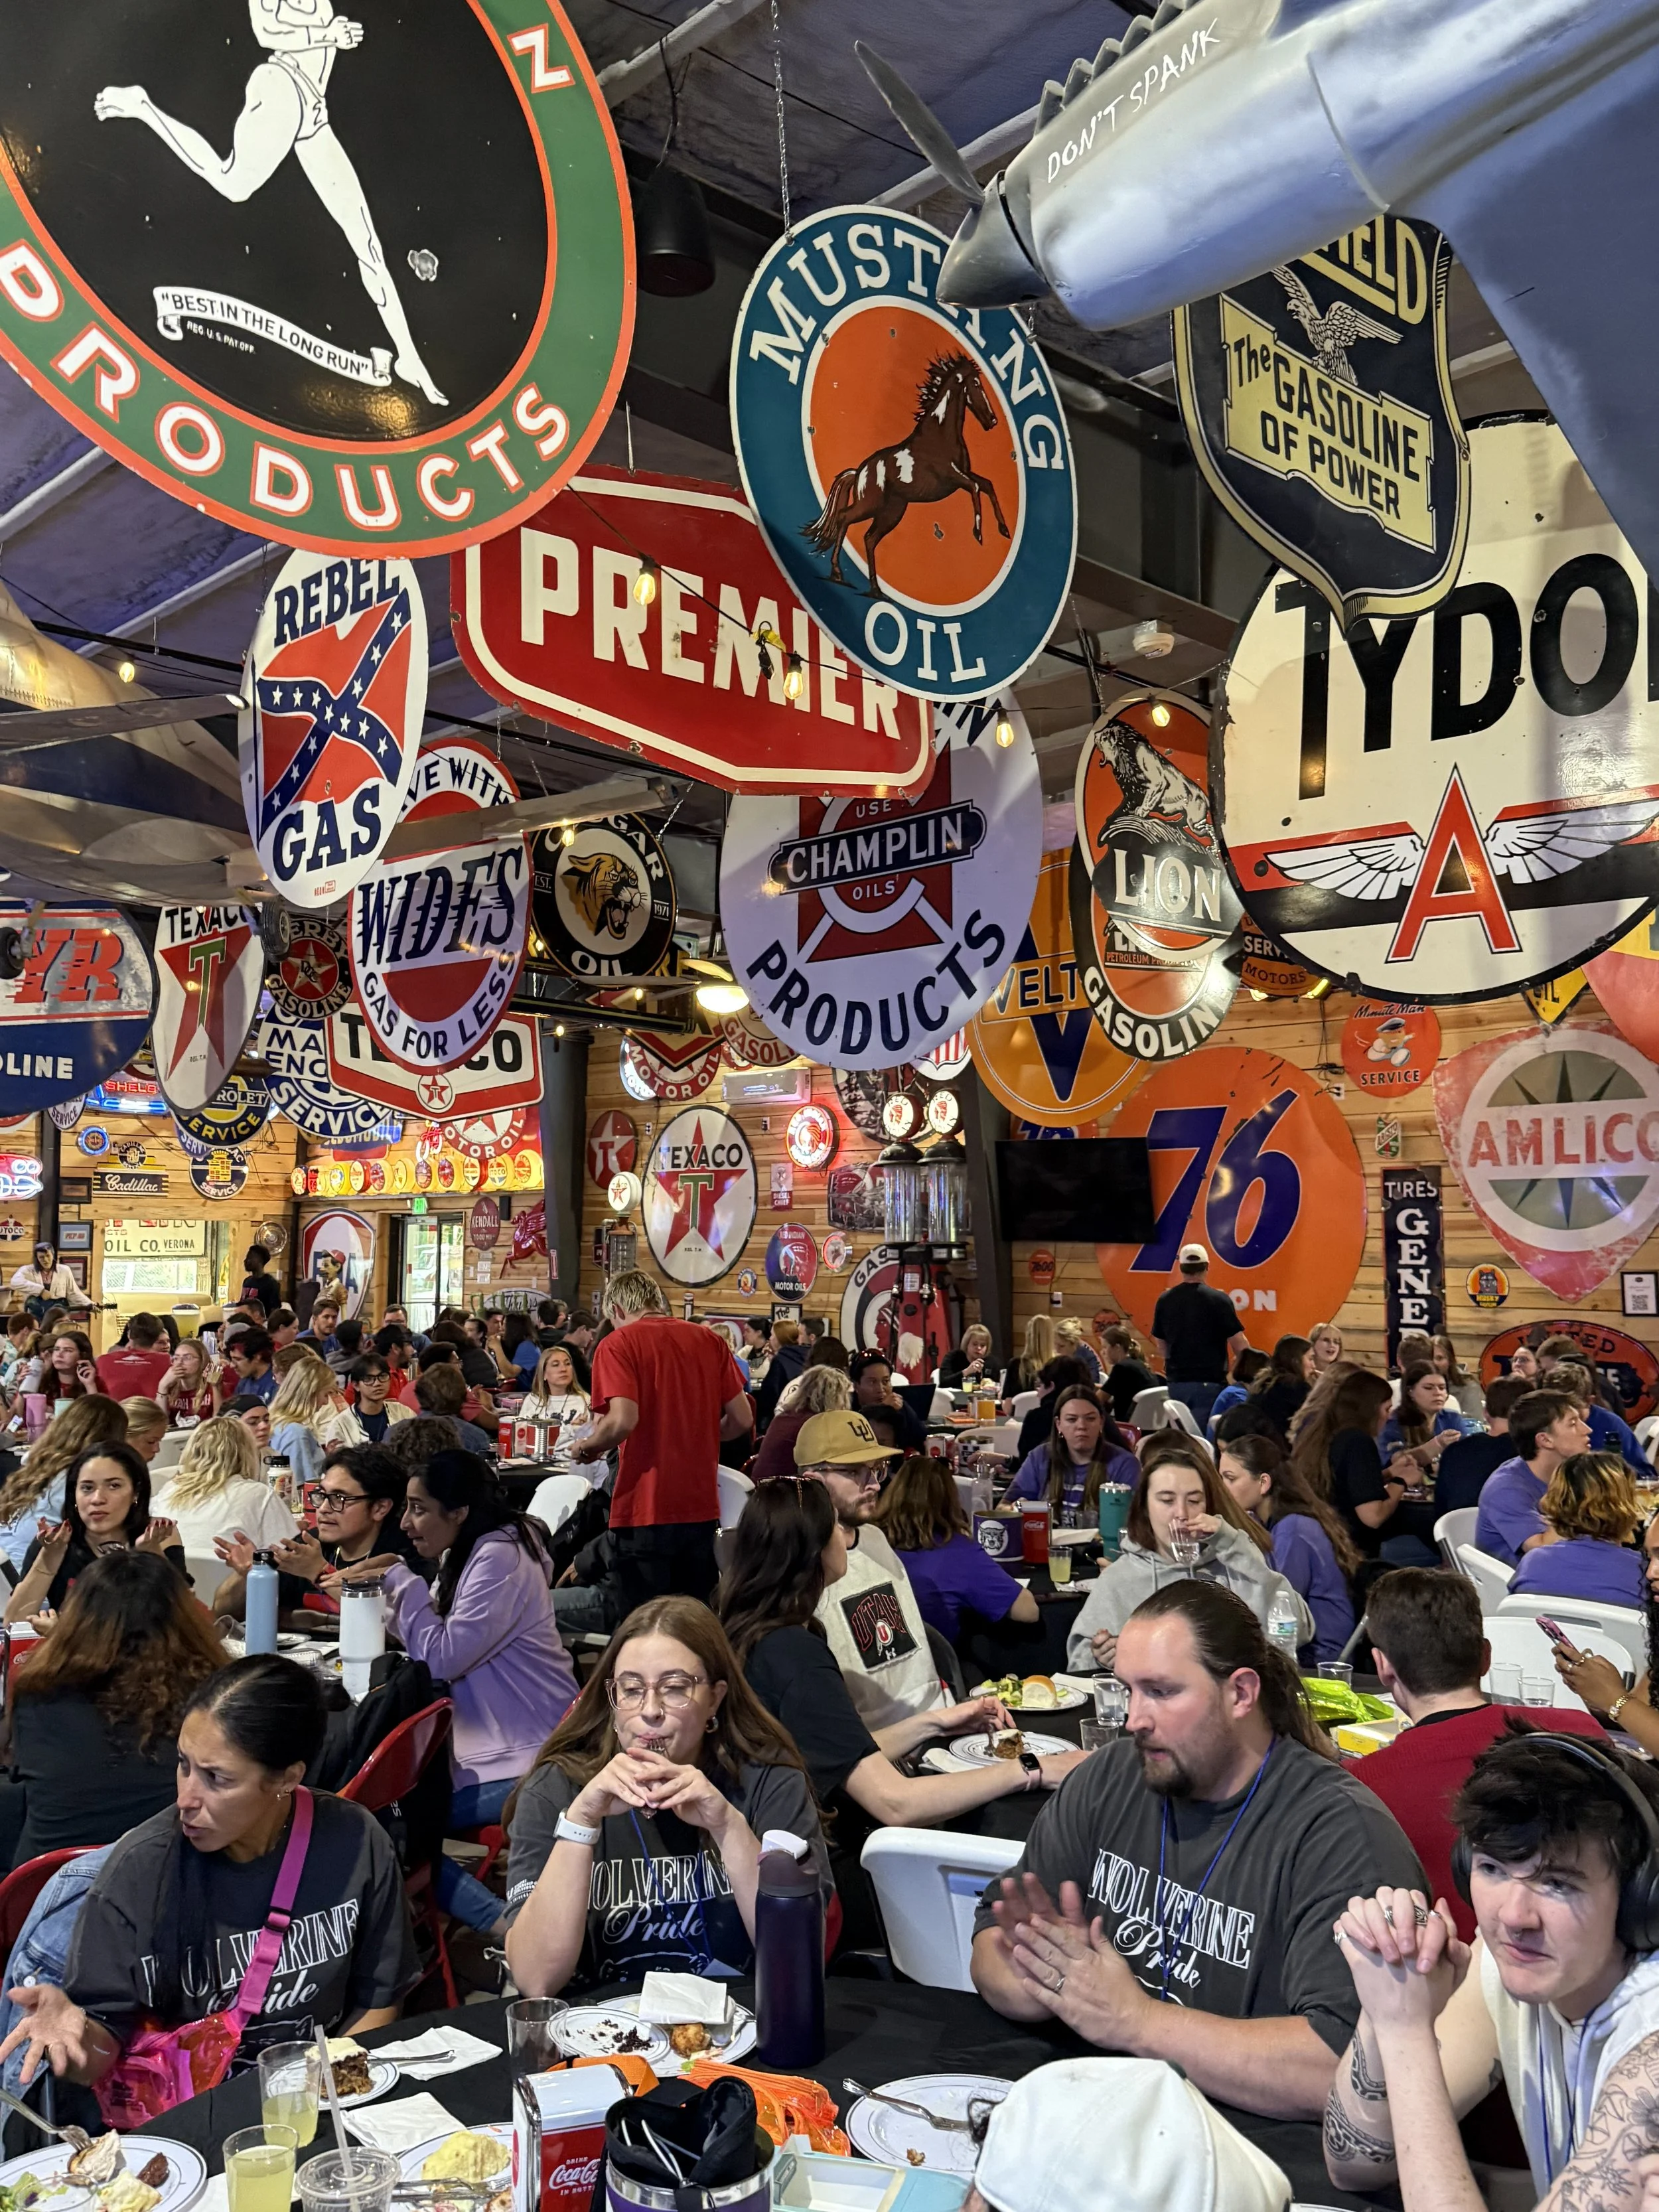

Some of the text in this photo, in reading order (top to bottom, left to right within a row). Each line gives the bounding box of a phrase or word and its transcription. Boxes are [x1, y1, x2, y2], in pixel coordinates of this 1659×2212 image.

[1046, 18, 1221, 183] DON'T SPANK
[219, 305, 238, 322] IN
[242, 308, 275, 336] THE
[279, 325, 323, 360] LONG
[0, 240, 570, 531] PRODUCTS
[1233, 332, 1420, 482] The GASOLINE
[1261, 411, 1400, 520] OF POWER
[274, 559, 399, 648] REBEL
[521, 526, 901, 741] PREMIER
[865, 601, 986, 683] OIL
[448, 757, 510, 809] WITH
[855, 800, 893, 819] USE
[274, 785, 381, 881] GAS
[543, 814, 664, 881] CGAR
[786, 812, 964, 884] CHAMPLIN
[534, 874, 552, 891] EST.
[1115, 849, 1221, 923] LION
[1385, 763, 1523, 964] A
[356, 846, 524, 969] WIDES
[852, 880, 897, 900] OILS
[289, 921, 348, 958] ERBY
[1106, 952, 1149, 965] PETROLEUM
[571, 950, 633, 977] OIL
[746, 909, 1005, 1055] PRODUCTS
[1245, 963, 1307, 985] MOTORS
[268, 973, 352, 1019] GASOLINE
[363, 947, 515, 1061] GAS FOR LESS
[995, 962, 1080, 1016] VELT
[1354, 1003, 1426, 1019] Minute Man
[724, 1018, 798, 1063] GASOLI
[0, 1053, 73, 1080] LINE
[629, 1045, 719, 1098] MOTOR OIL
[1360, 1070, 1420, 1086] SERVICE
[51, 1105, 78, 1126] SERVICE
[217, 1090, 266, 1106] ROLET
[270, 1081, 391, 1136] SERVICE
[180, 1132, 207, 1155] SERV
[181, 1111, 261, 1141] ERVICE
[444, 1119, 524, 1159] OTOR OIL
[659, 1143, 743, 1169] TEXACO
[105, 1173, 158, 1192] Cadillac
[200, 1182, 238, 1197] SERVICE
[1129, 1088, 1301, 1273] 76
[1384, 1181, 1437, 1200] TIRES
[471, 1215, 498, 1228] KENDALL
[105, 1238, 195, 1252] OIL CO. VERONA
[774, 1282, 794, 1291] MOTOR
[851, 1593, 907, 1652] UTAH
[587, 1849, 733, 1910] OLVERIN
[603, 1901, 705, 1945] Pride
[1087, 1848, 1256, 1970] WOLVERINE
[1112, 1918, 1201, 1988] Pride
[572, 2185, 595, 2194] BOTT
